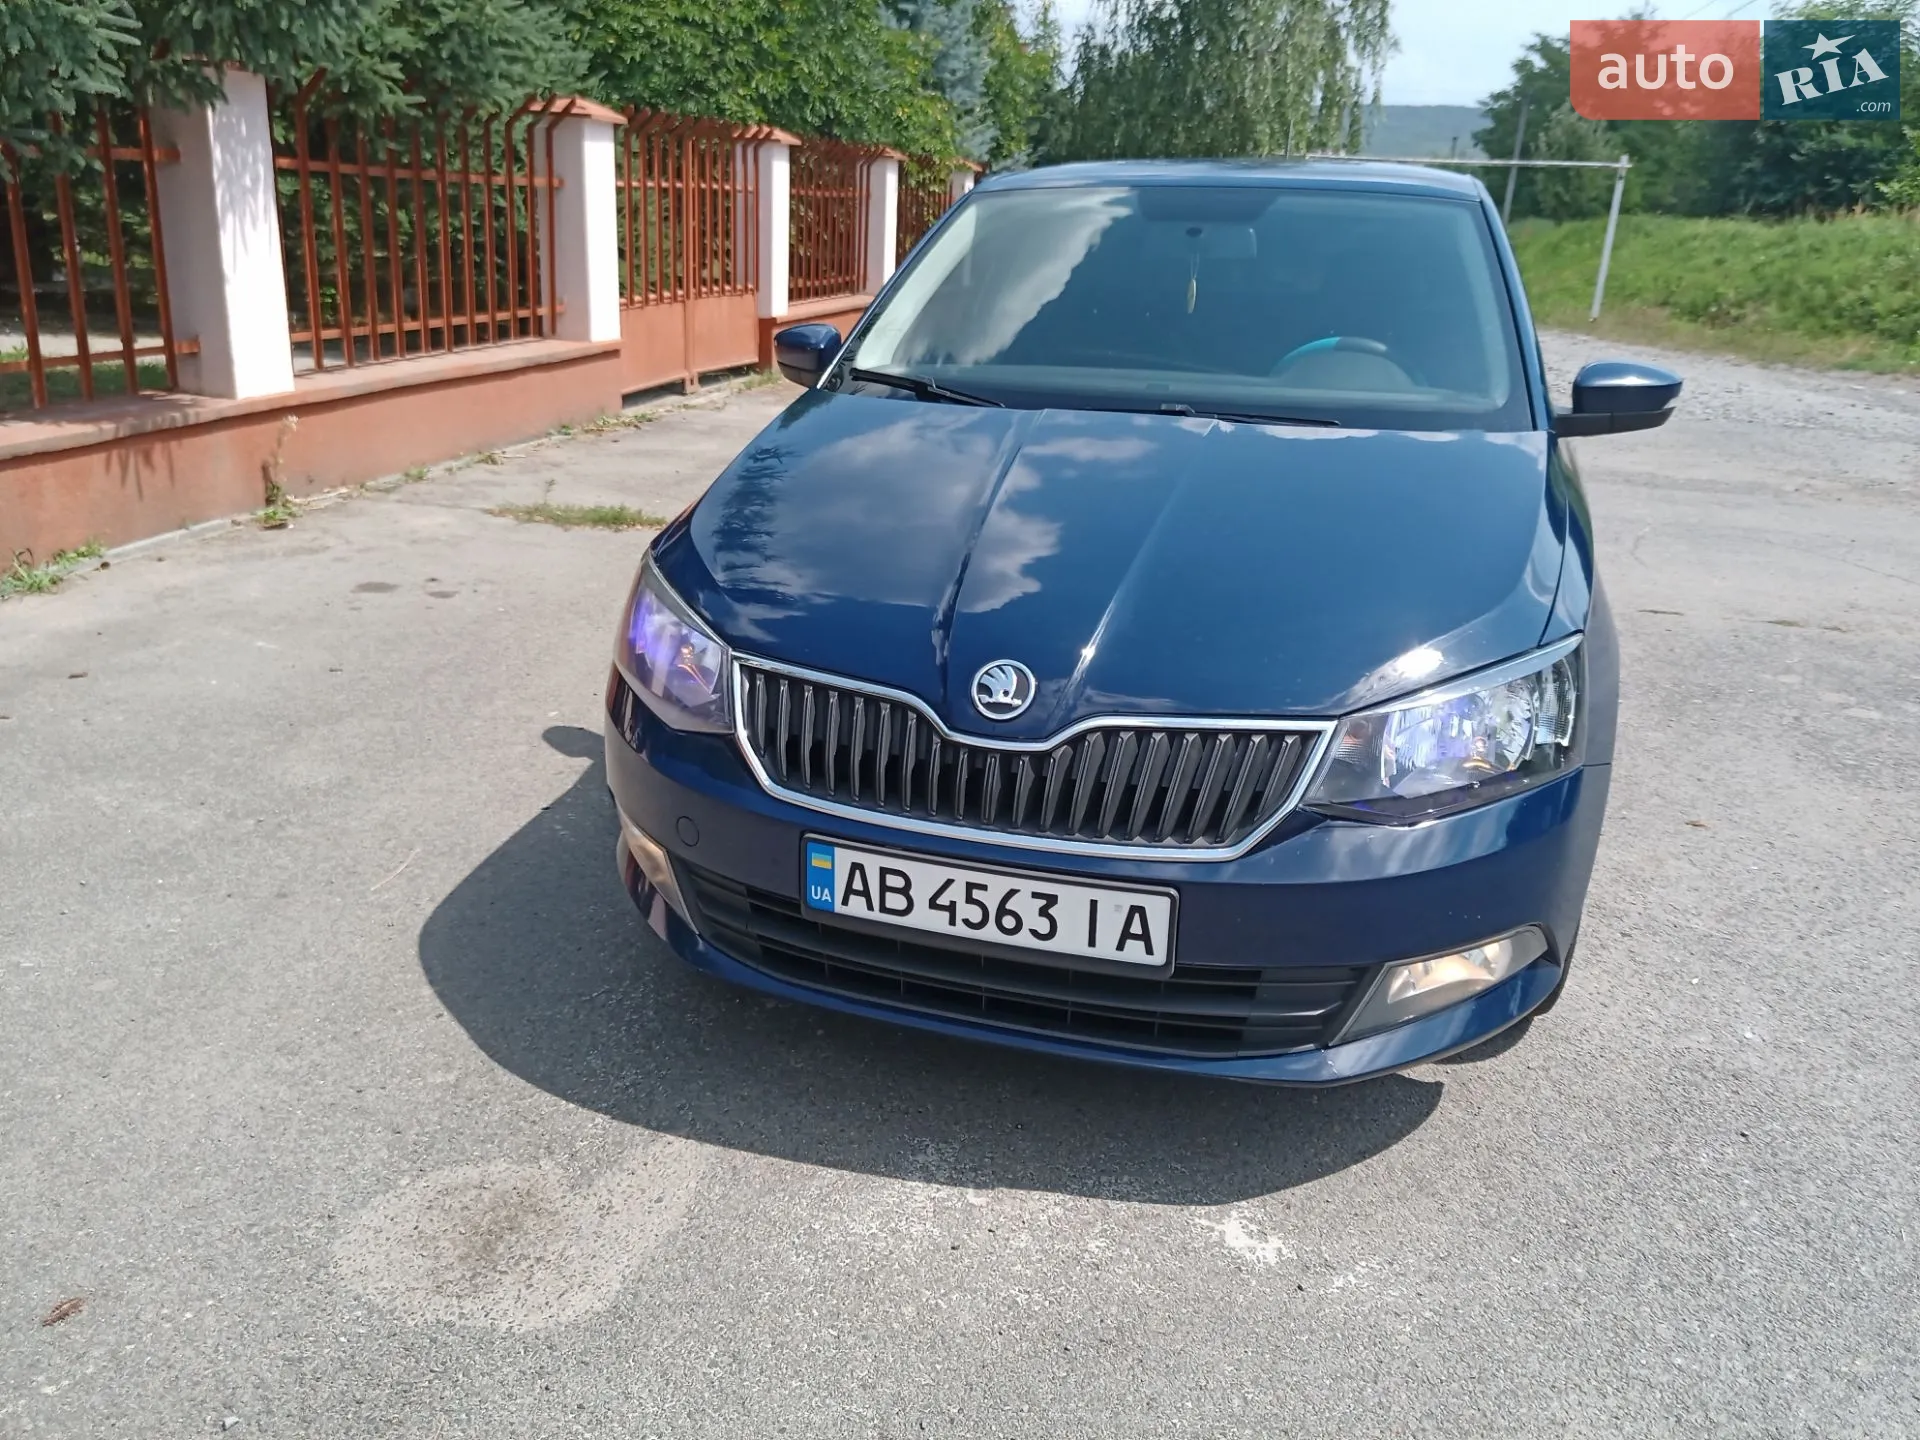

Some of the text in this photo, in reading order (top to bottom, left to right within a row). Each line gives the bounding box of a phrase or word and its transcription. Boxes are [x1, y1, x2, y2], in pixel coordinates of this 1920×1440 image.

[811, 885, 832, 903] UA
[841, 861, 1154, 956] AB 4563 IA
